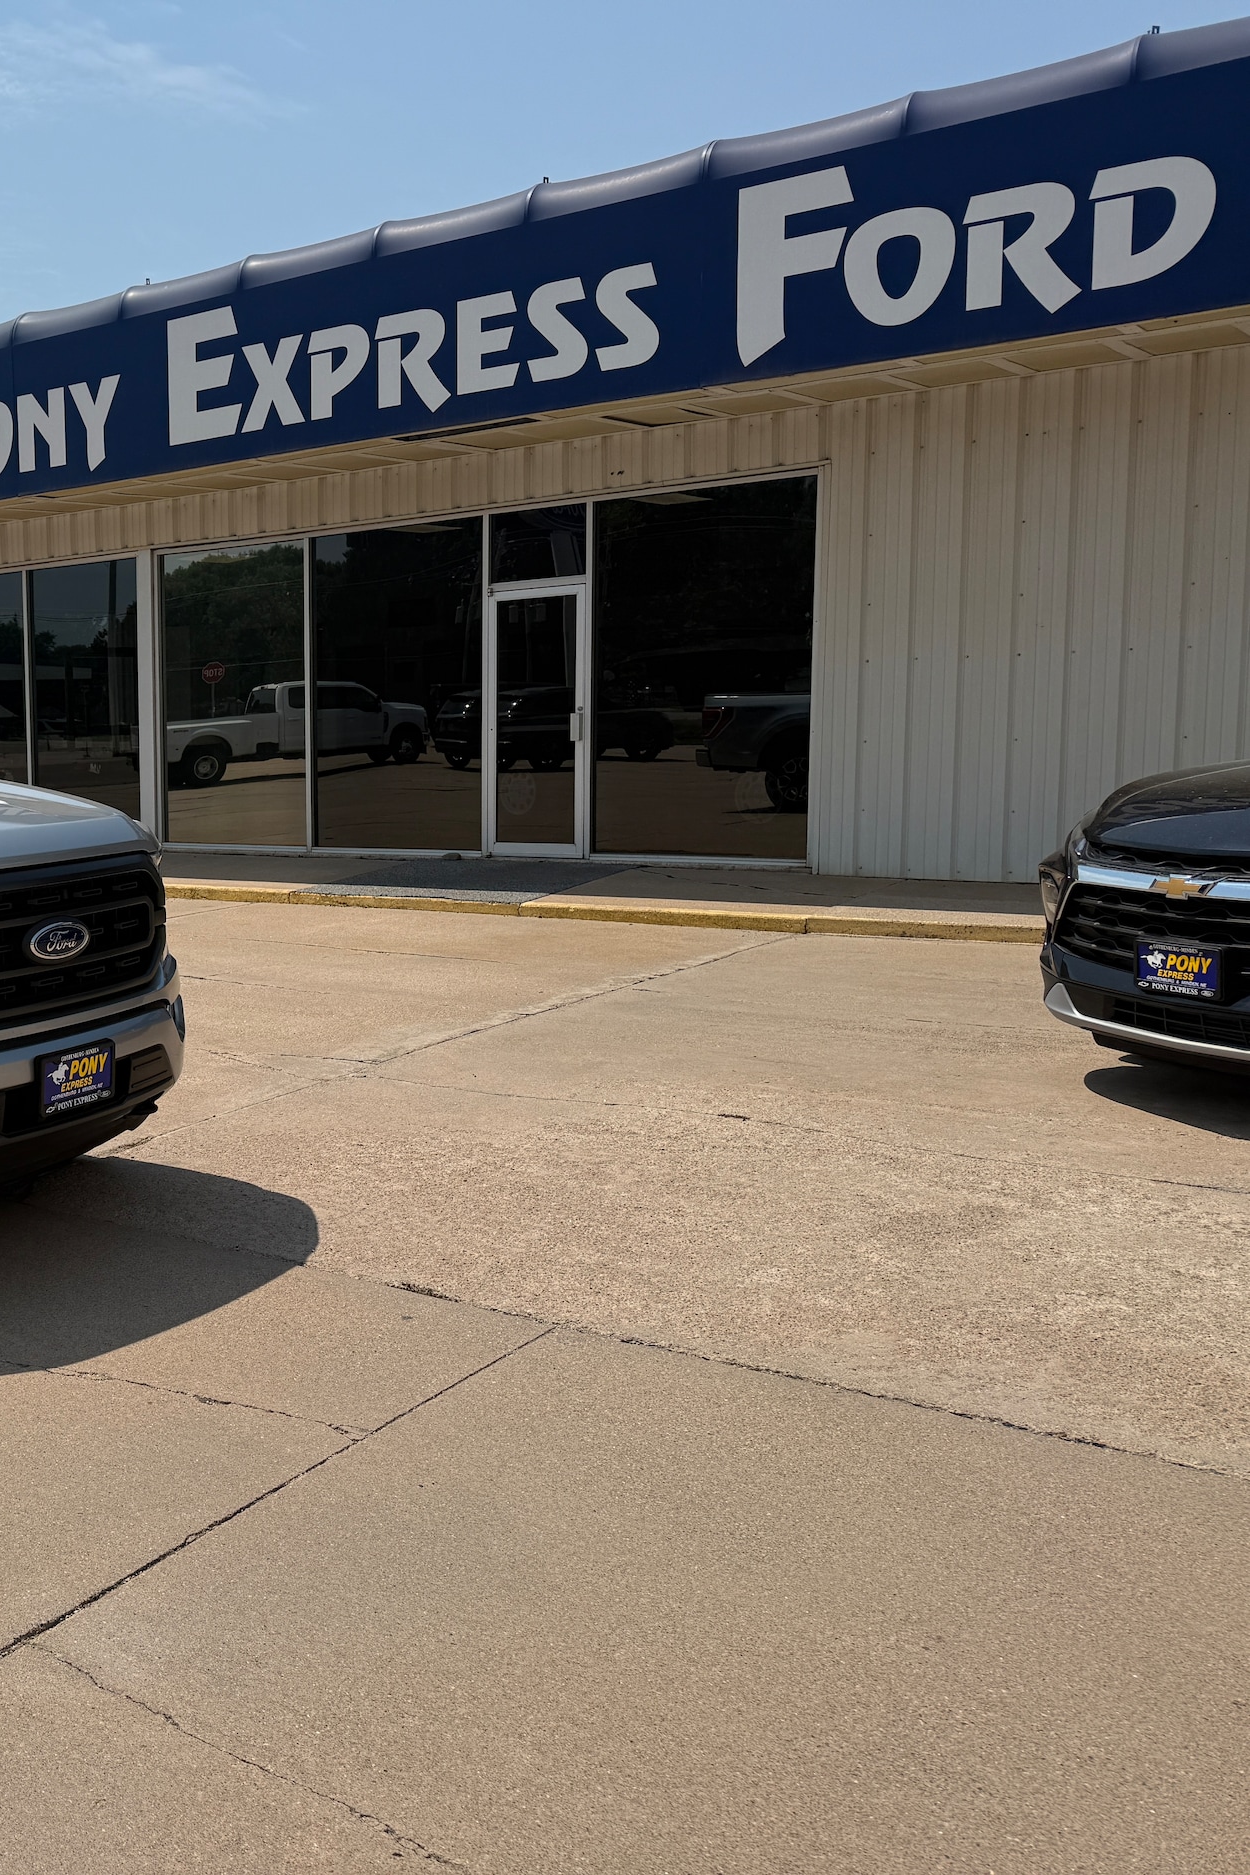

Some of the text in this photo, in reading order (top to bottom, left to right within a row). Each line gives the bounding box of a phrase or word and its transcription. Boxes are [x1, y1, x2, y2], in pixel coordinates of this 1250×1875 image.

[166, 263, 660, 447] EXPRESS
[47, 930, 77, 952] Ford
[1166, 954, 1212, 974] PONY
[1157, 969, 1194, 981] EXPRESS
[1152, 983, 1169, 992] PONY
[1170, 985, 1198, 996] EXPRESS
[69, 1052, 109, 1080] PONY
[61, 1076, 93, 1093] EXPRESS
[58, 1099, 73, 1111] PONY
[74, 1093, 98, 1106] EXPRESS
